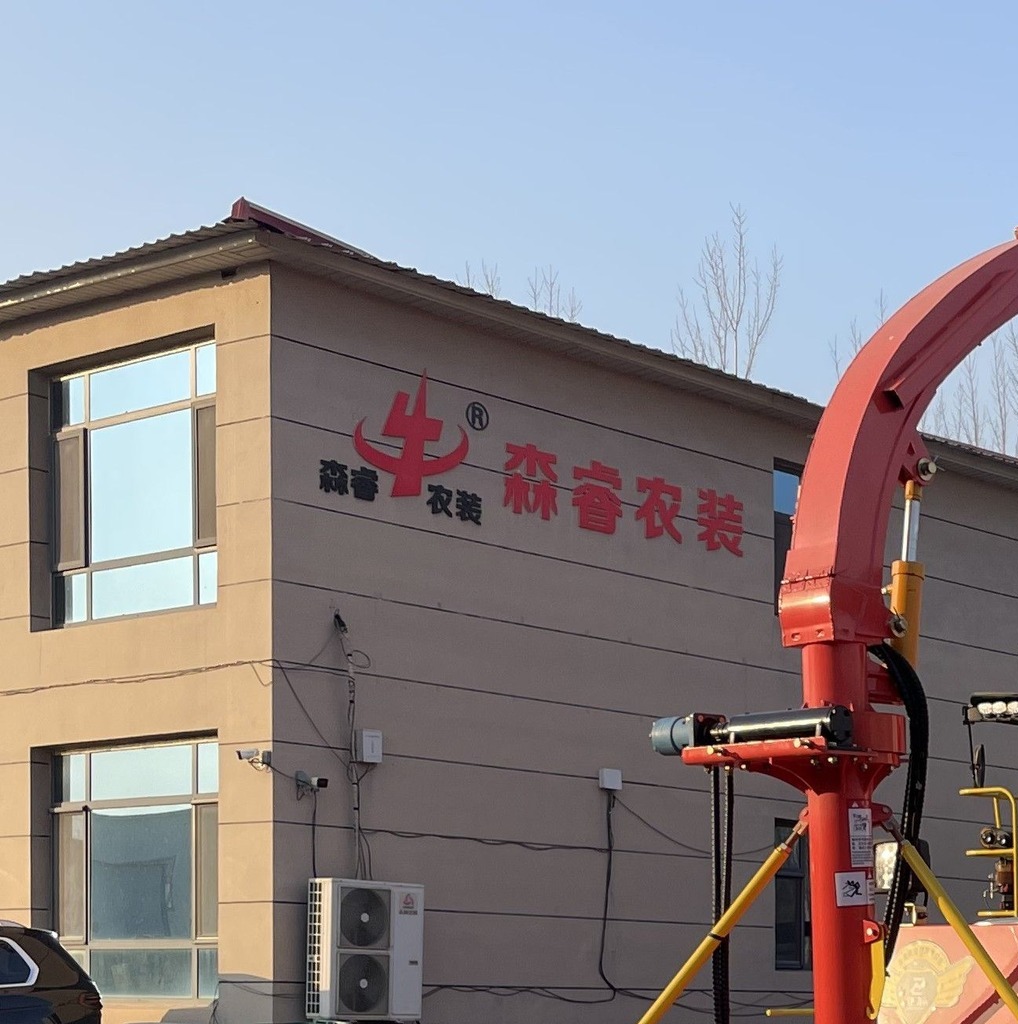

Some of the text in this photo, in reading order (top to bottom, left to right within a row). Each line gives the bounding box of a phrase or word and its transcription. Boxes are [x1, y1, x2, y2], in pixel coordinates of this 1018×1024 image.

[319, 459, 483, 525] 森睿 农装
[502, 443, 744, 557] 森睿农装
